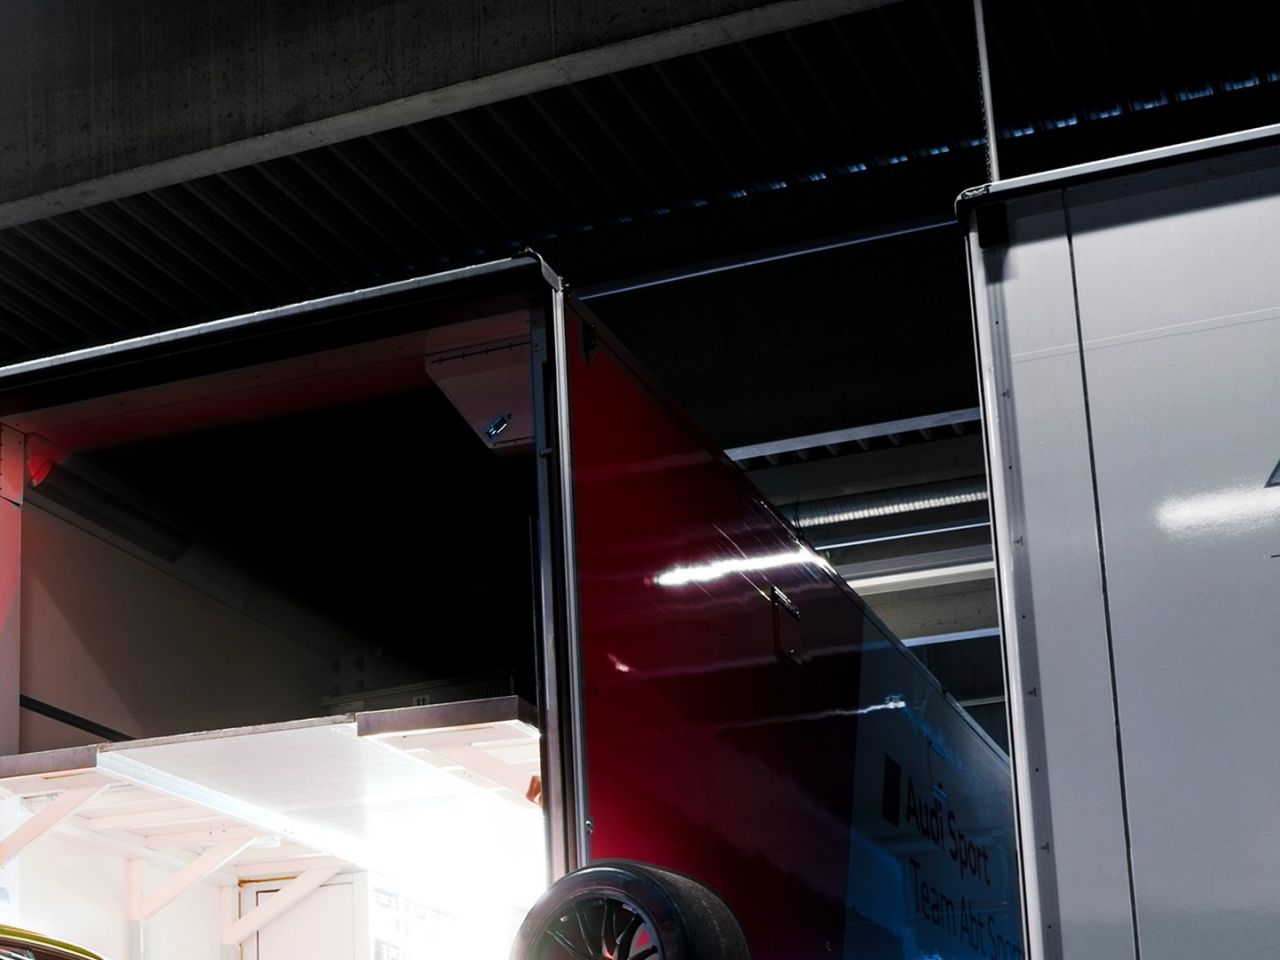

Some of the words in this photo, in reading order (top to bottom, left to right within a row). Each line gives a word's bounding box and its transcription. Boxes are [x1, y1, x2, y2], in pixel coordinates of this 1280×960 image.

[906, 775, 945, 850] Audi
[949, 810, 991, 887] Sport
[910, 858, 957, 937] Team
[960, 897, 987, 957] Abt
